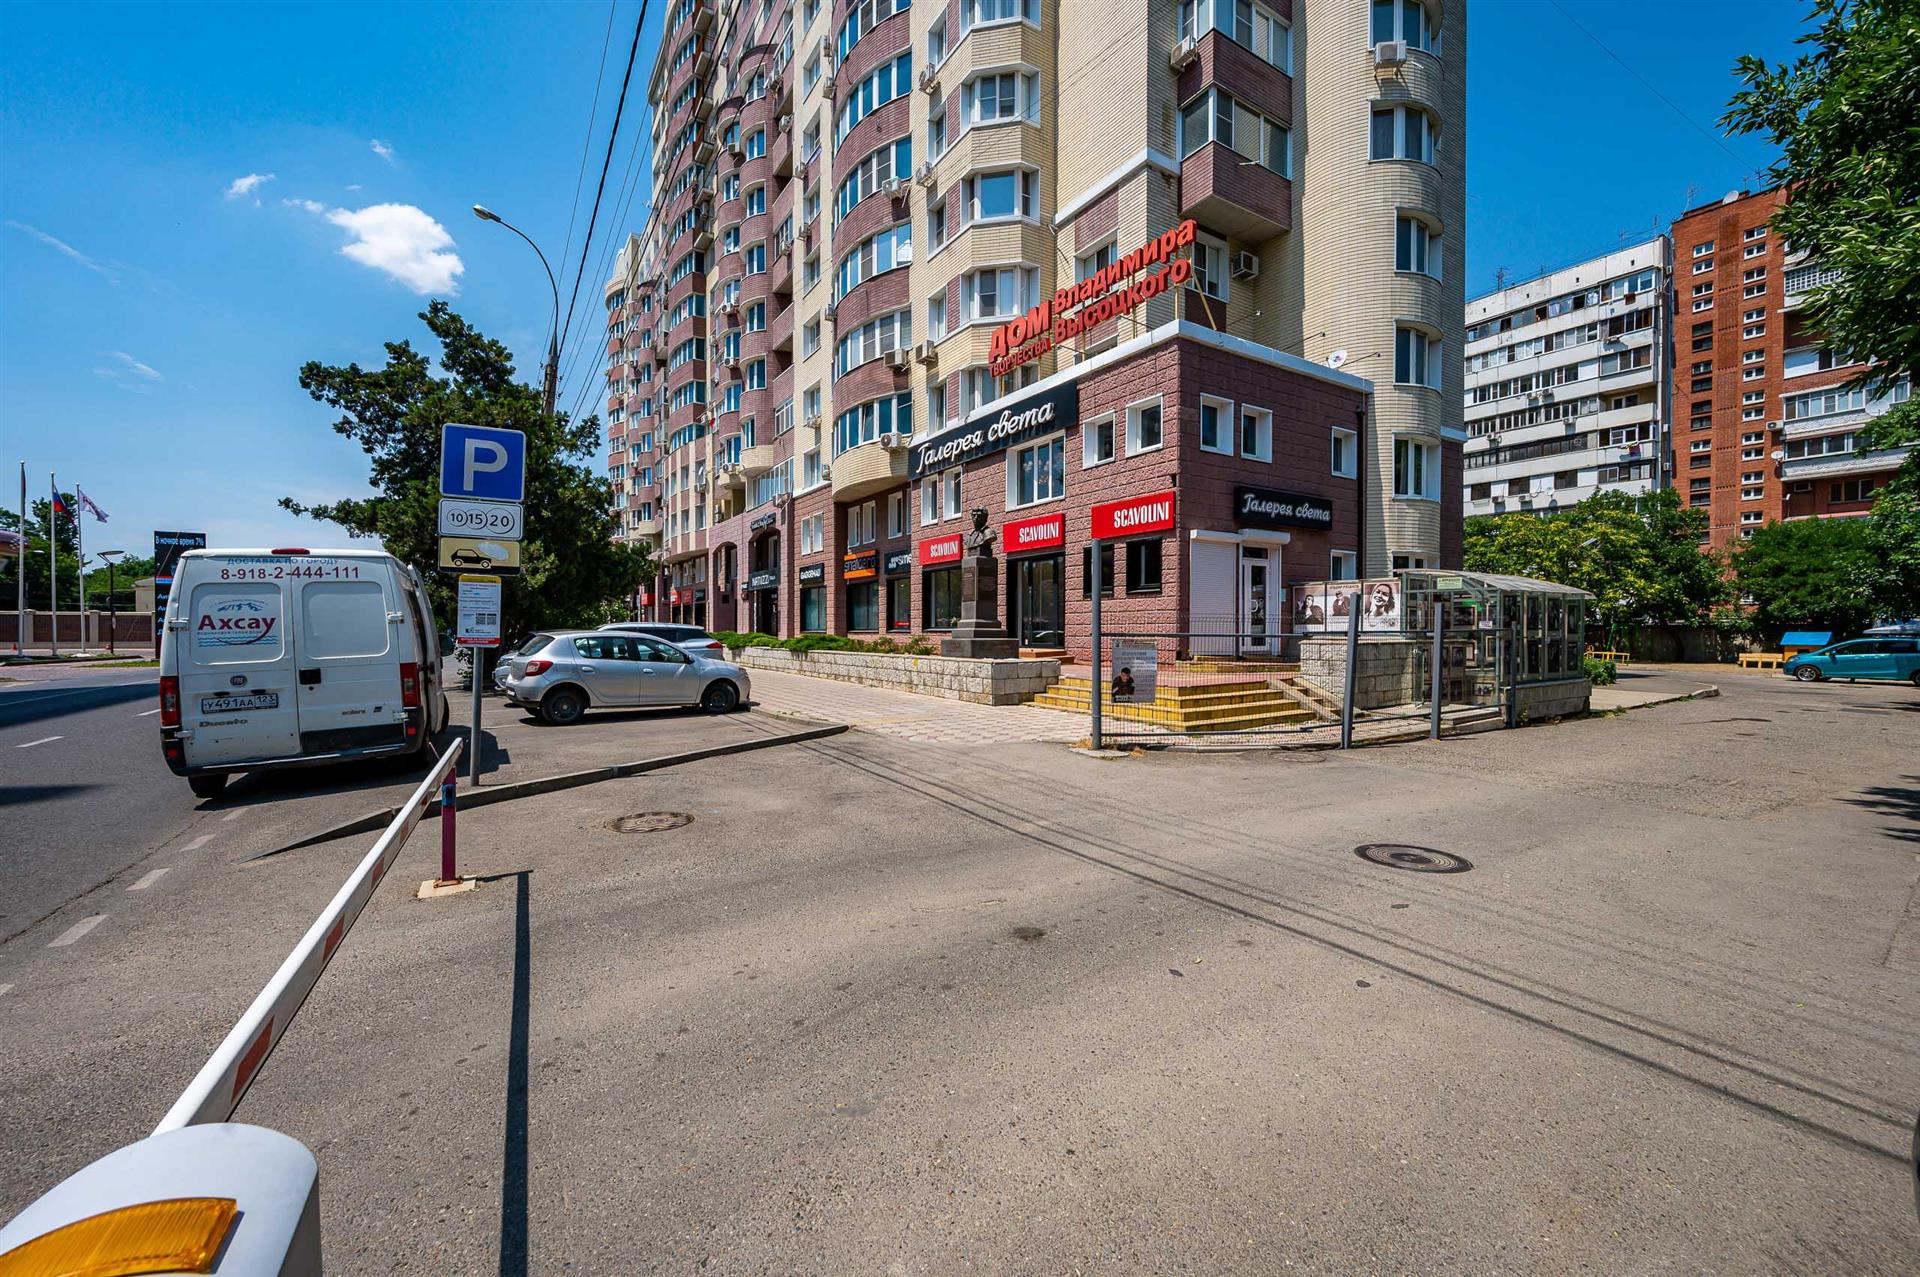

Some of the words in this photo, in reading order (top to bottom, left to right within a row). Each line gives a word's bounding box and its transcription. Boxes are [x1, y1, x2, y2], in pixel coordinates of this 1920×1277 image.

[1054, 218, 1197, 313] Владимира
[1054, 258, 1193, 344] Высоцкого
[989, 299, 1052, 363] ДОМ
[989, 337, 1051, 378] ТВОРЧЕСТВА
[916, 430, 985, 473] Галерея
[987, 402, 1056, 442] света
[463, 438, 508, 491] P
[451, 513, 464, 523] 10
[468, 514, 483, 525] 15
[489, 514, 510, 528] 20
[1113, 500, 1170, 529] SCAVOLINI
[1242, 493, 1293, 517] Галерея
[1296, 503, 1331, 522] света
[1019, 522, 1059, 543] SCAVOLINI
[930, 541, 958, 557] SCAVOLINI
[220, 566, 360, 580] 8-918-2-444-111
[198, 614, 276, 641] Ахсау
[199, 718, 248, 727] Ducato
